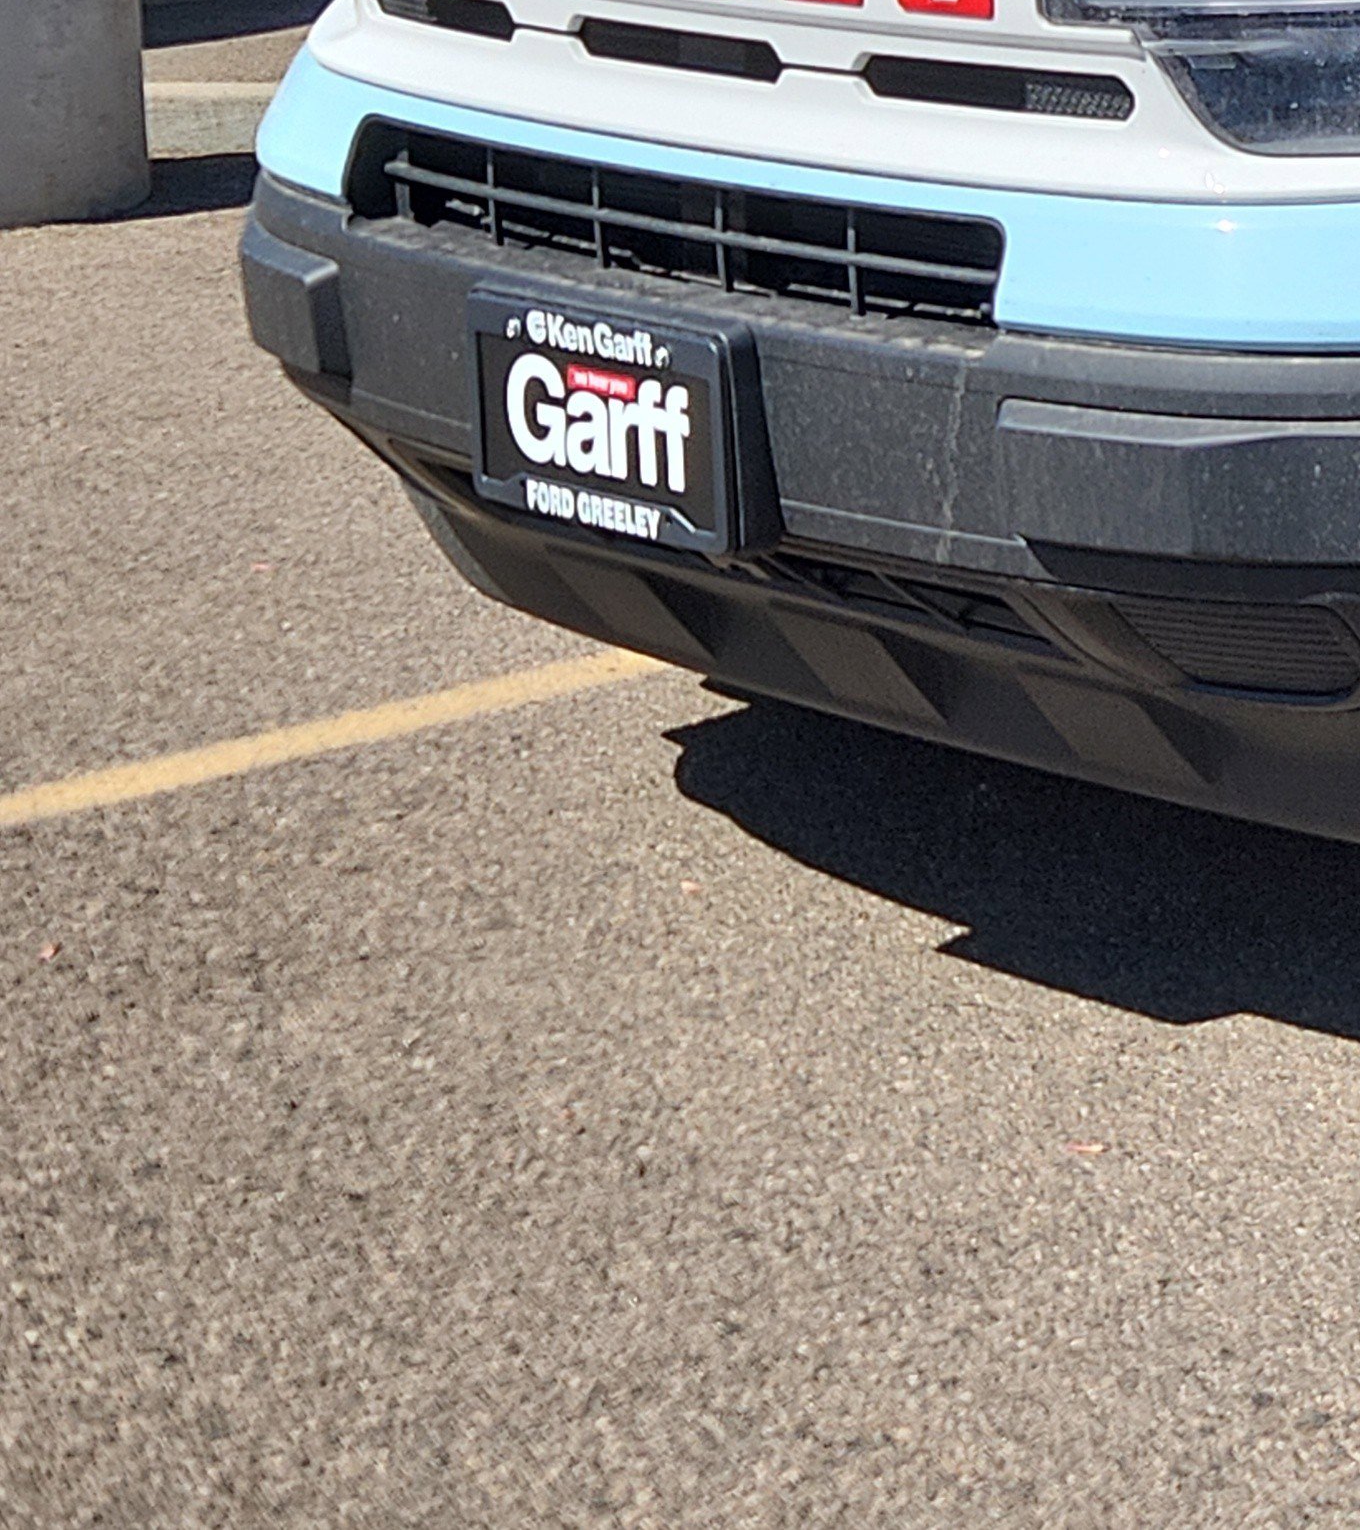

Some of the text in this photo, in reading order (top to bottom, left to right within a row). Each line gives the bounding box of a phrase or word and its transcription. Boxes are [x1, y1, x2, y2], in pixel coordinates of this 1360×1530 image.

[546, 312, 653, 367] Ken Garff
[506, 353, 690, 493] Garff
[526, 479, 662, 540] FORD GREELEY
